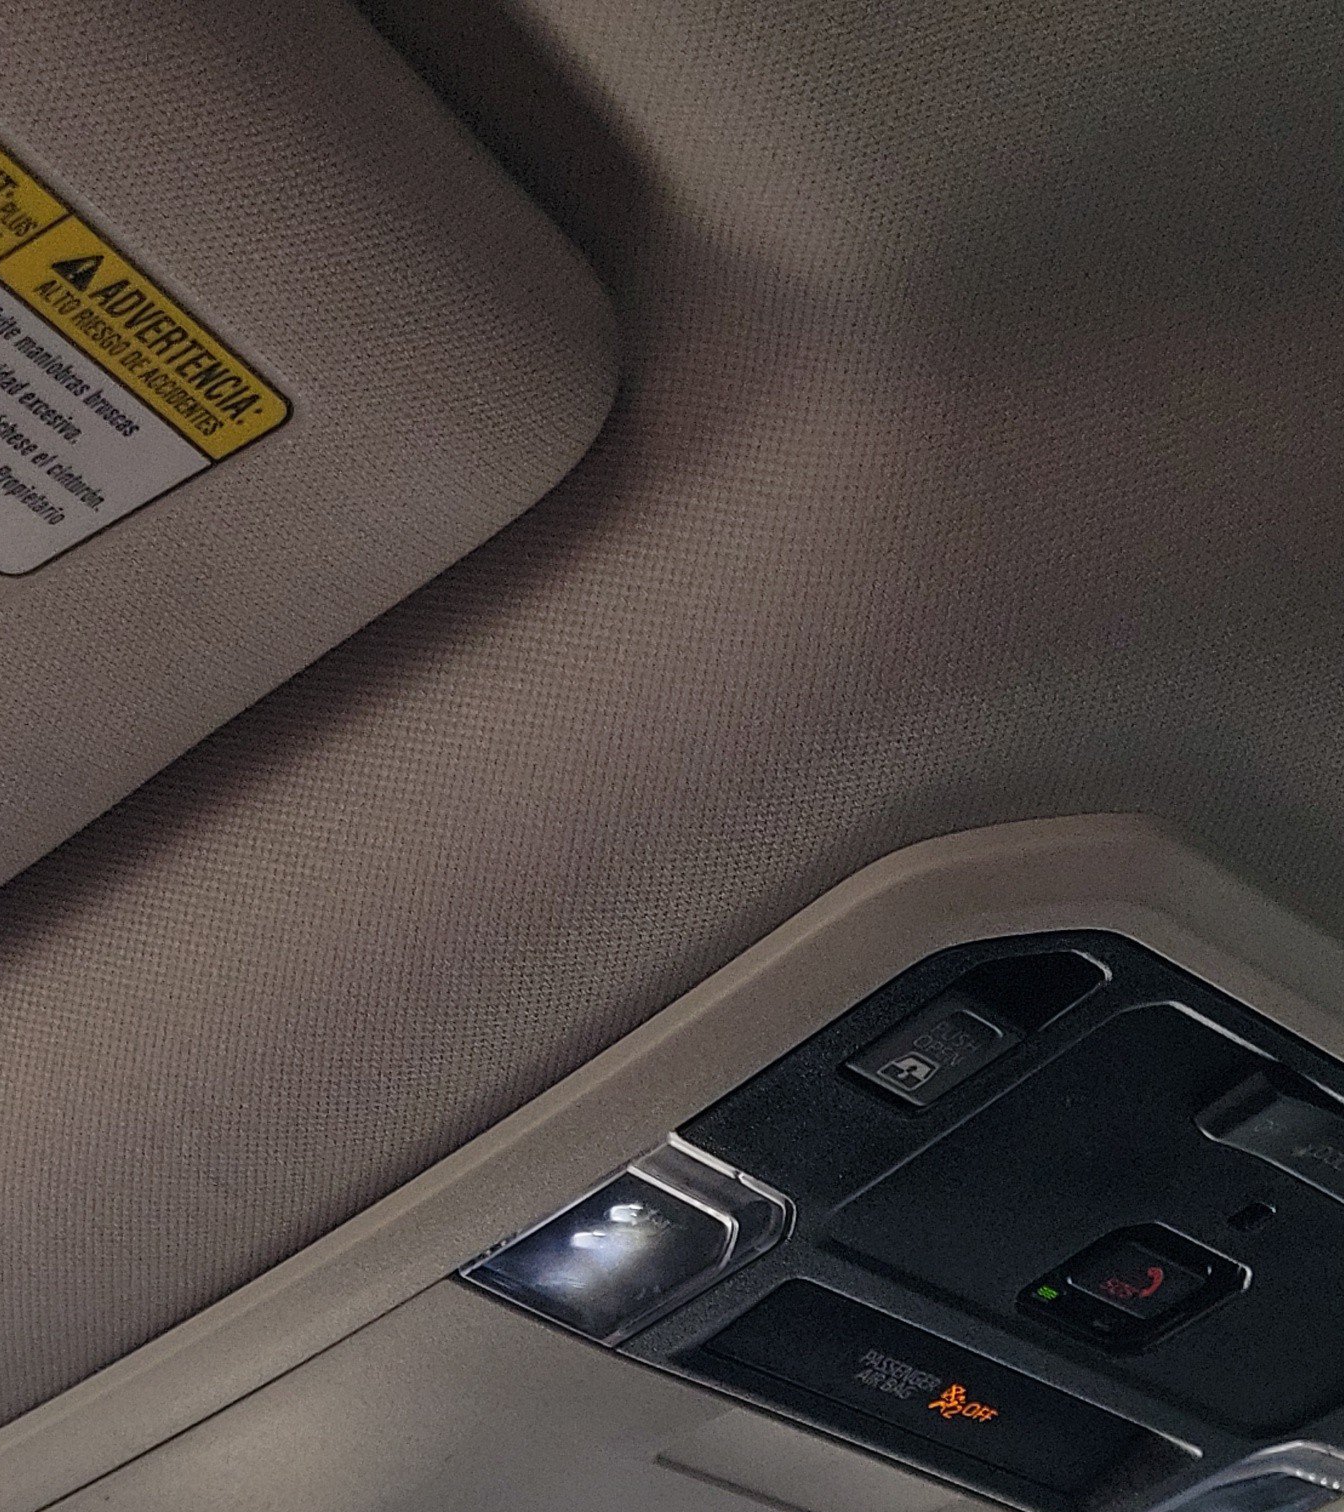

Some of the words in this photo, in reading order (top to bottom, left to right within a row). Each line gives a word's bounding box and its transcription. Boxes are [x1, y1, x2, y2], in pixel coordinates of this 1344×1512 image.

[13, 335, 91, 397] maniobras
[82, 388, 140, 438] bruscas
[33, 279, 82, 315] ALTO
[70, 308, 131, 356] RIESGO
[118, 349, 152, 374] DE
[138, 367, 225, 437] ACCIDENTES
[88, 278, 263, 425] ADVERTENCIA:
[17, 391, 82, 444] excesiva.
[30, 451, 58, 468] el
[859, 1349, 941, 1392] PASSENGER
[961, 1401, 999, 1422] OFF
